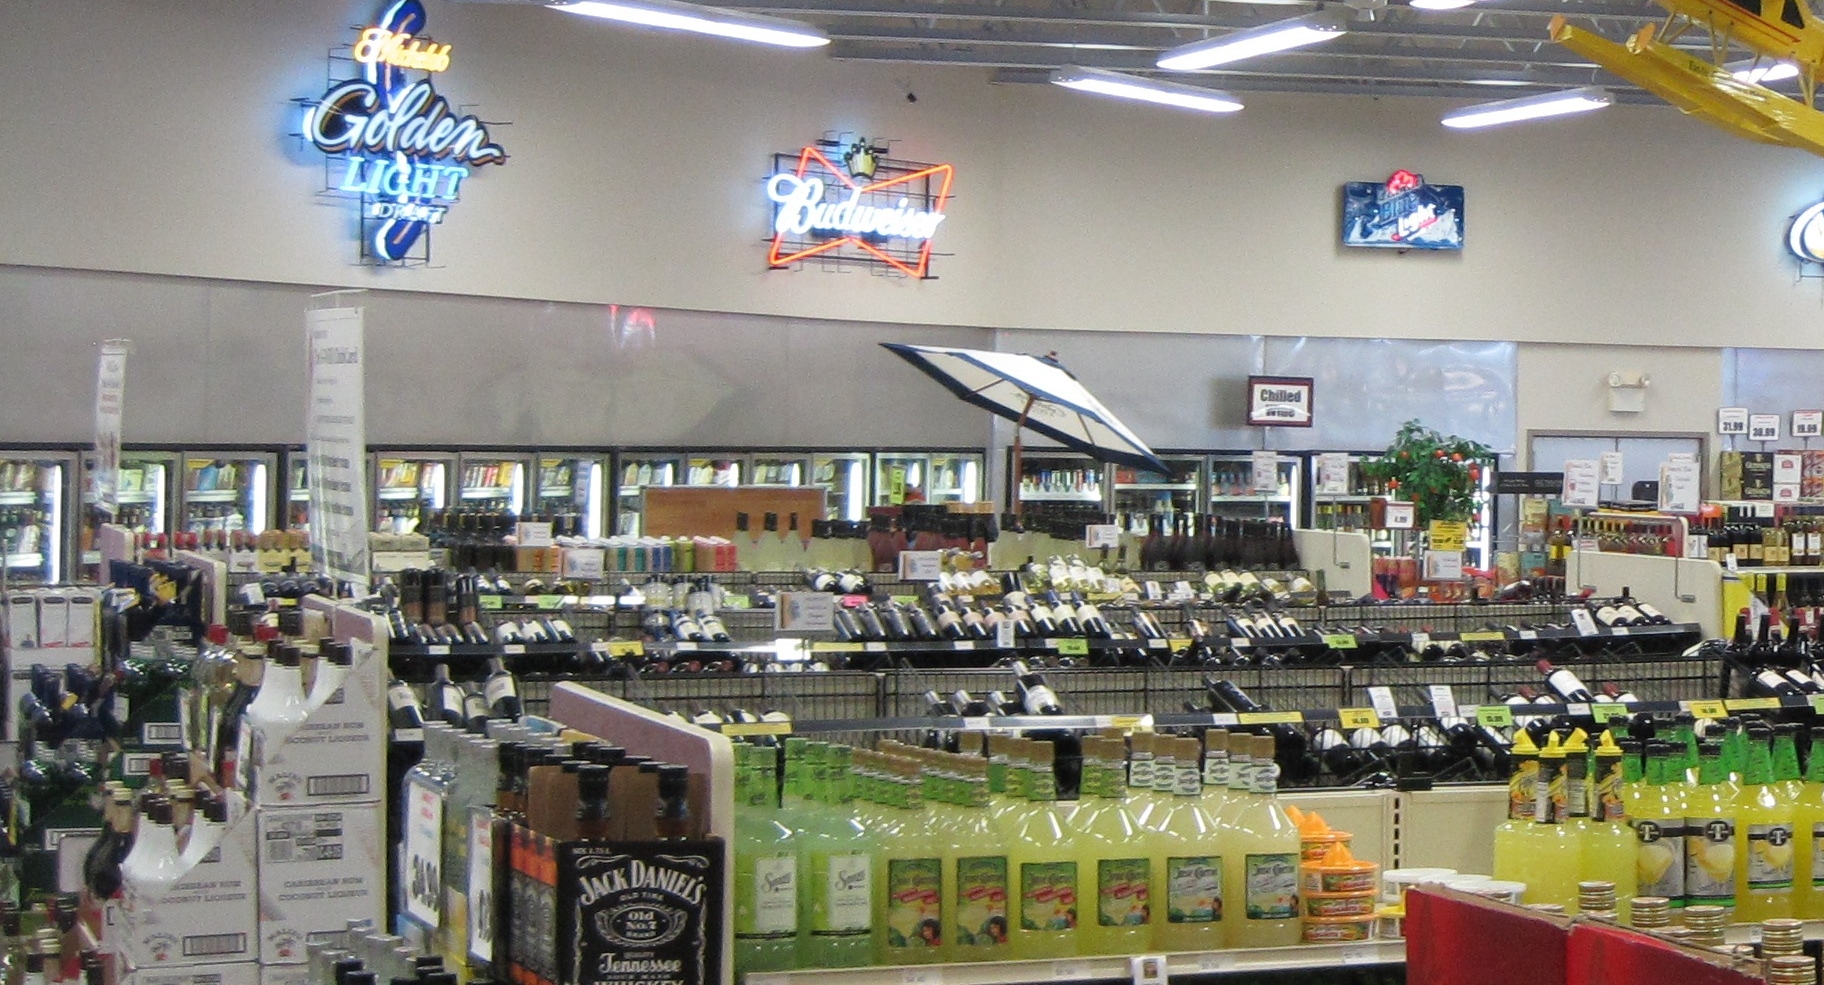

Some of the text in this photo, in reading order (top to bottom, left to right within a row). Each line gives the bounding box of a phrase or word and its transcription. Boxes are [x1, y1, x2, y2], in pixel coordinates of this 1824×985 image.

[311, 78, 506, 164] Golden
[339, 155, 470, 202] LIGHT
[767, 173, 946, 240] Budweiser
[1260, 389, 1302, 403] Chilled
[579, 859, 707, 906] JACK DANIEL'S
[627, 910, 655, 921] Old
[598, 953, 682, 975] Tennessee
